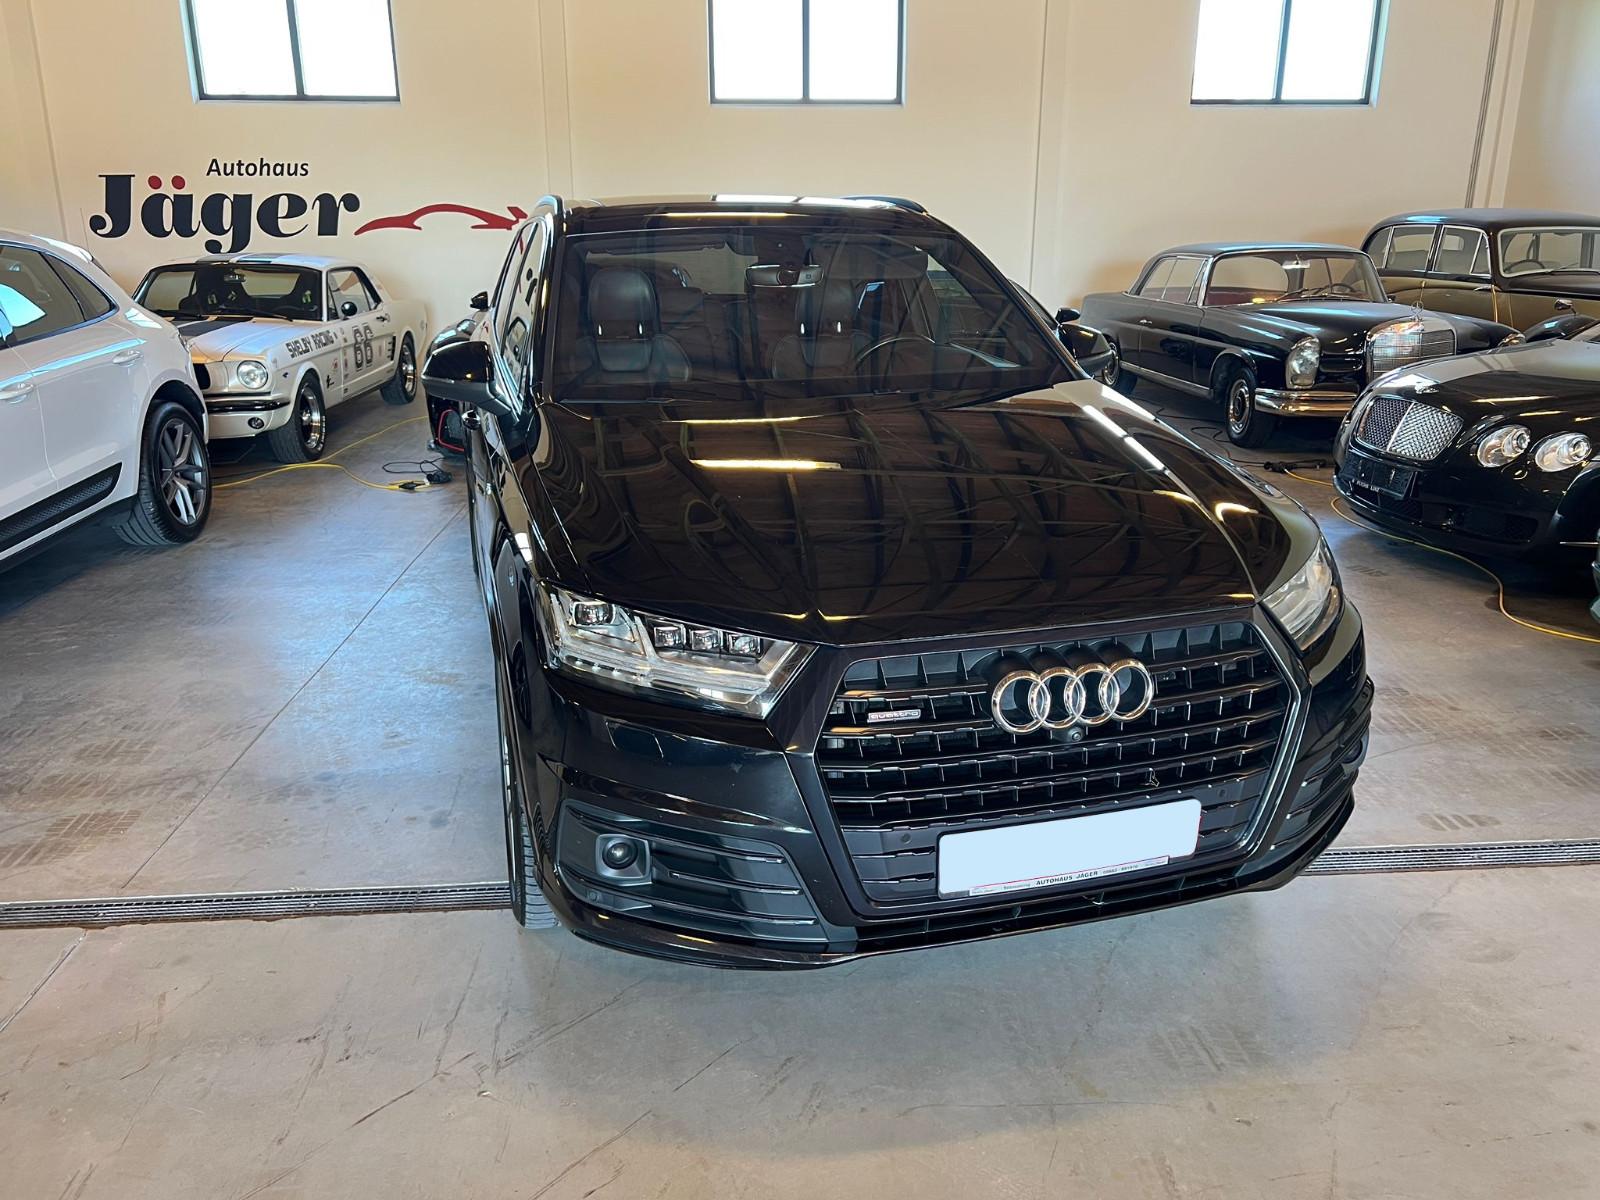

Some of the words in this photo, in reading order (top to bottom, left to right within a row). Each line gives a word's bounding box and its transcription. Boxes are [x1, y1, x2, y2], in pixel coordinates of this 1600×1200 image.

[206, 158, 309, 177] Autohaus
[89, 174, 360, 254] Jäger
[285, 336, 313, 359] SHELBY
[310, 330, 335, 350] RACING
[352, 322, 374, 372] 66
[869, 710, 920, 720] quattro
[1035, 874, 1074, 886] AUTOHAUS
